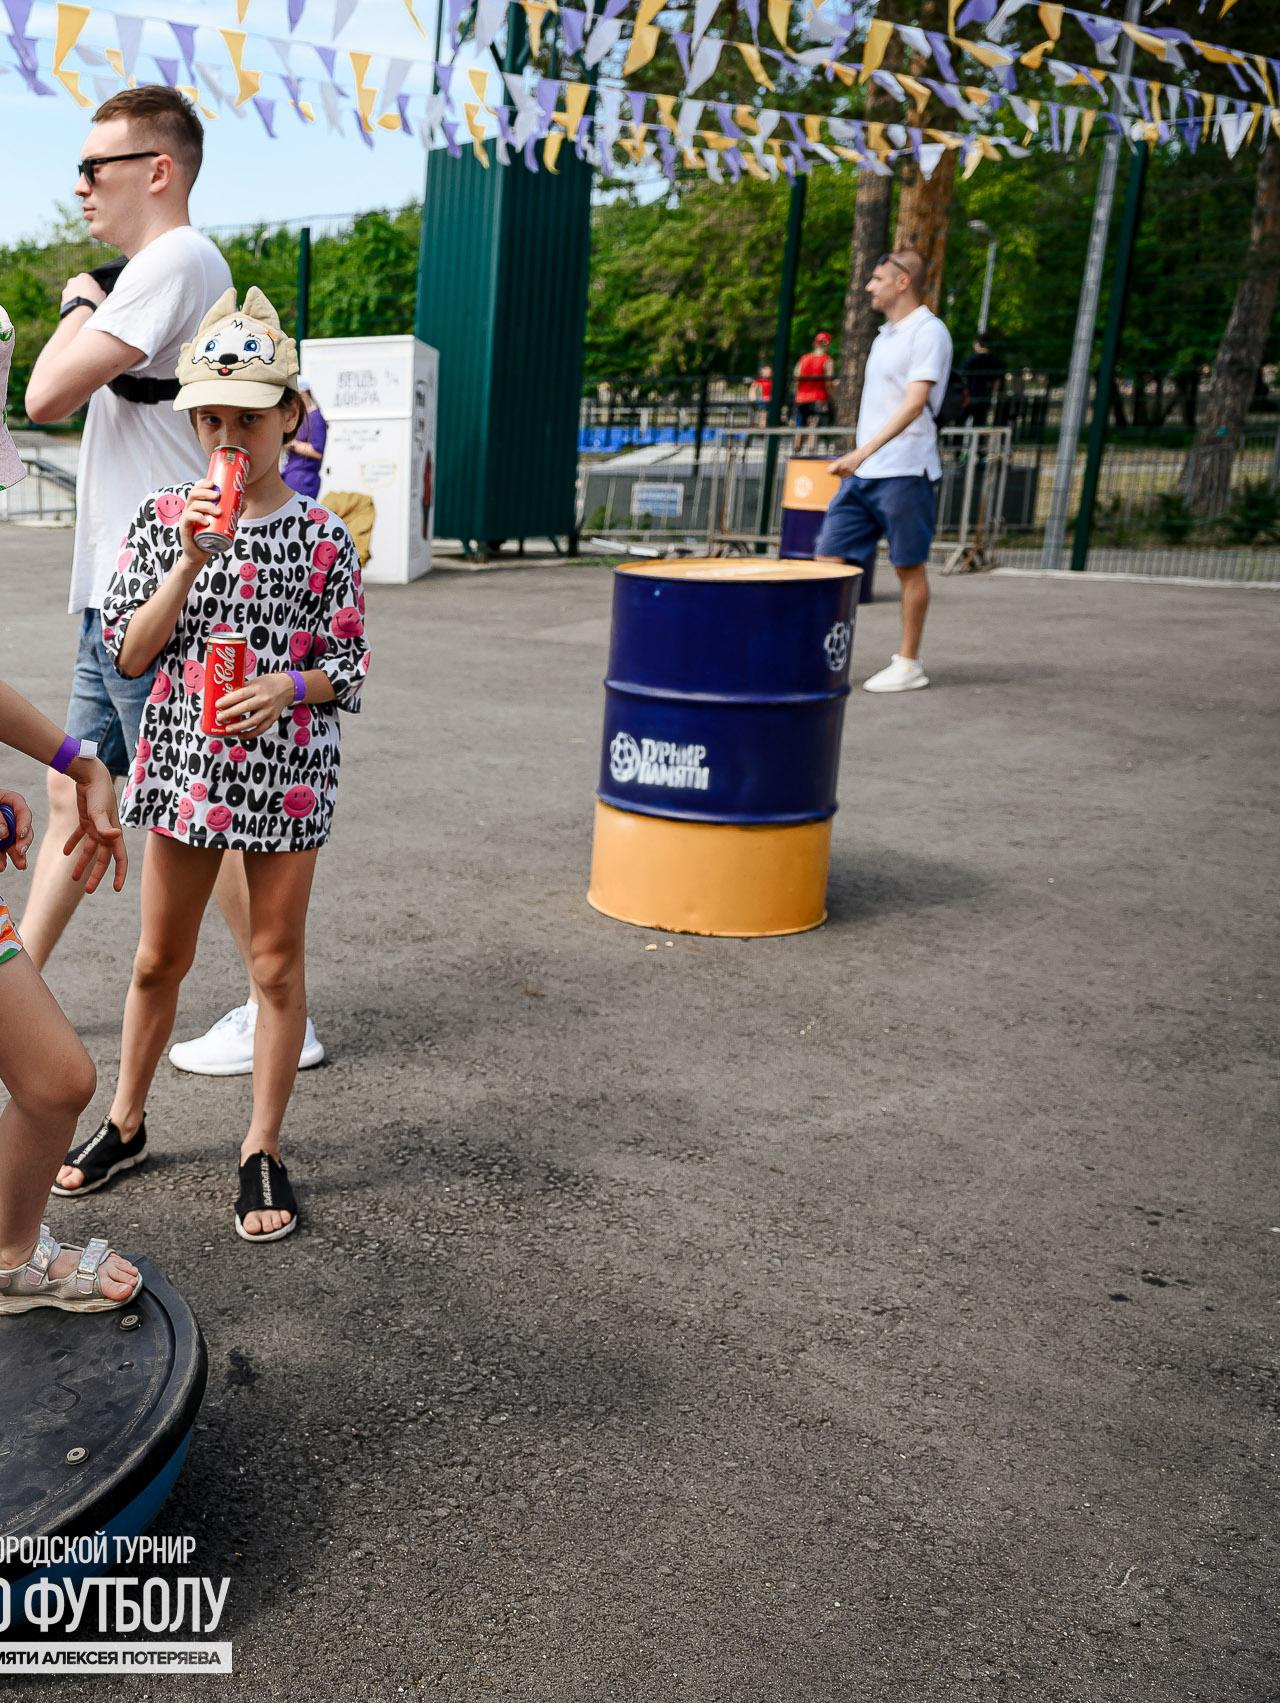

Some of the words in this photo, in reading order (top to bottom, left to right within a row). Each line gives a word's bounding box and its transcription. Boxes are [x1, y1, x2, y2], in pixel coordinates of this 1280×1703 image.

[234, 539, 315, 565] ENJOY
[195, 571, 240, 598] JOY
[256, 583, 303, 603] LOVE
[234, 602, 291, 626] ENJOY
[214, 646, 236, 684] Cola
[144, 724, 206, 752] HAPPY
[148, 763, 189, 792] LOVE
[152, 743, 215, 778] ENJOY
[211, 761, 278, 788] ENJOY
[280, 765, 327, 790] HAPPY
[135, 788, 179, 808] LOVE
[208, 782, 284, 814] LOVE
[125, 804, 178, 831] APPY
[232, 813, 292, 838] HAPPY
